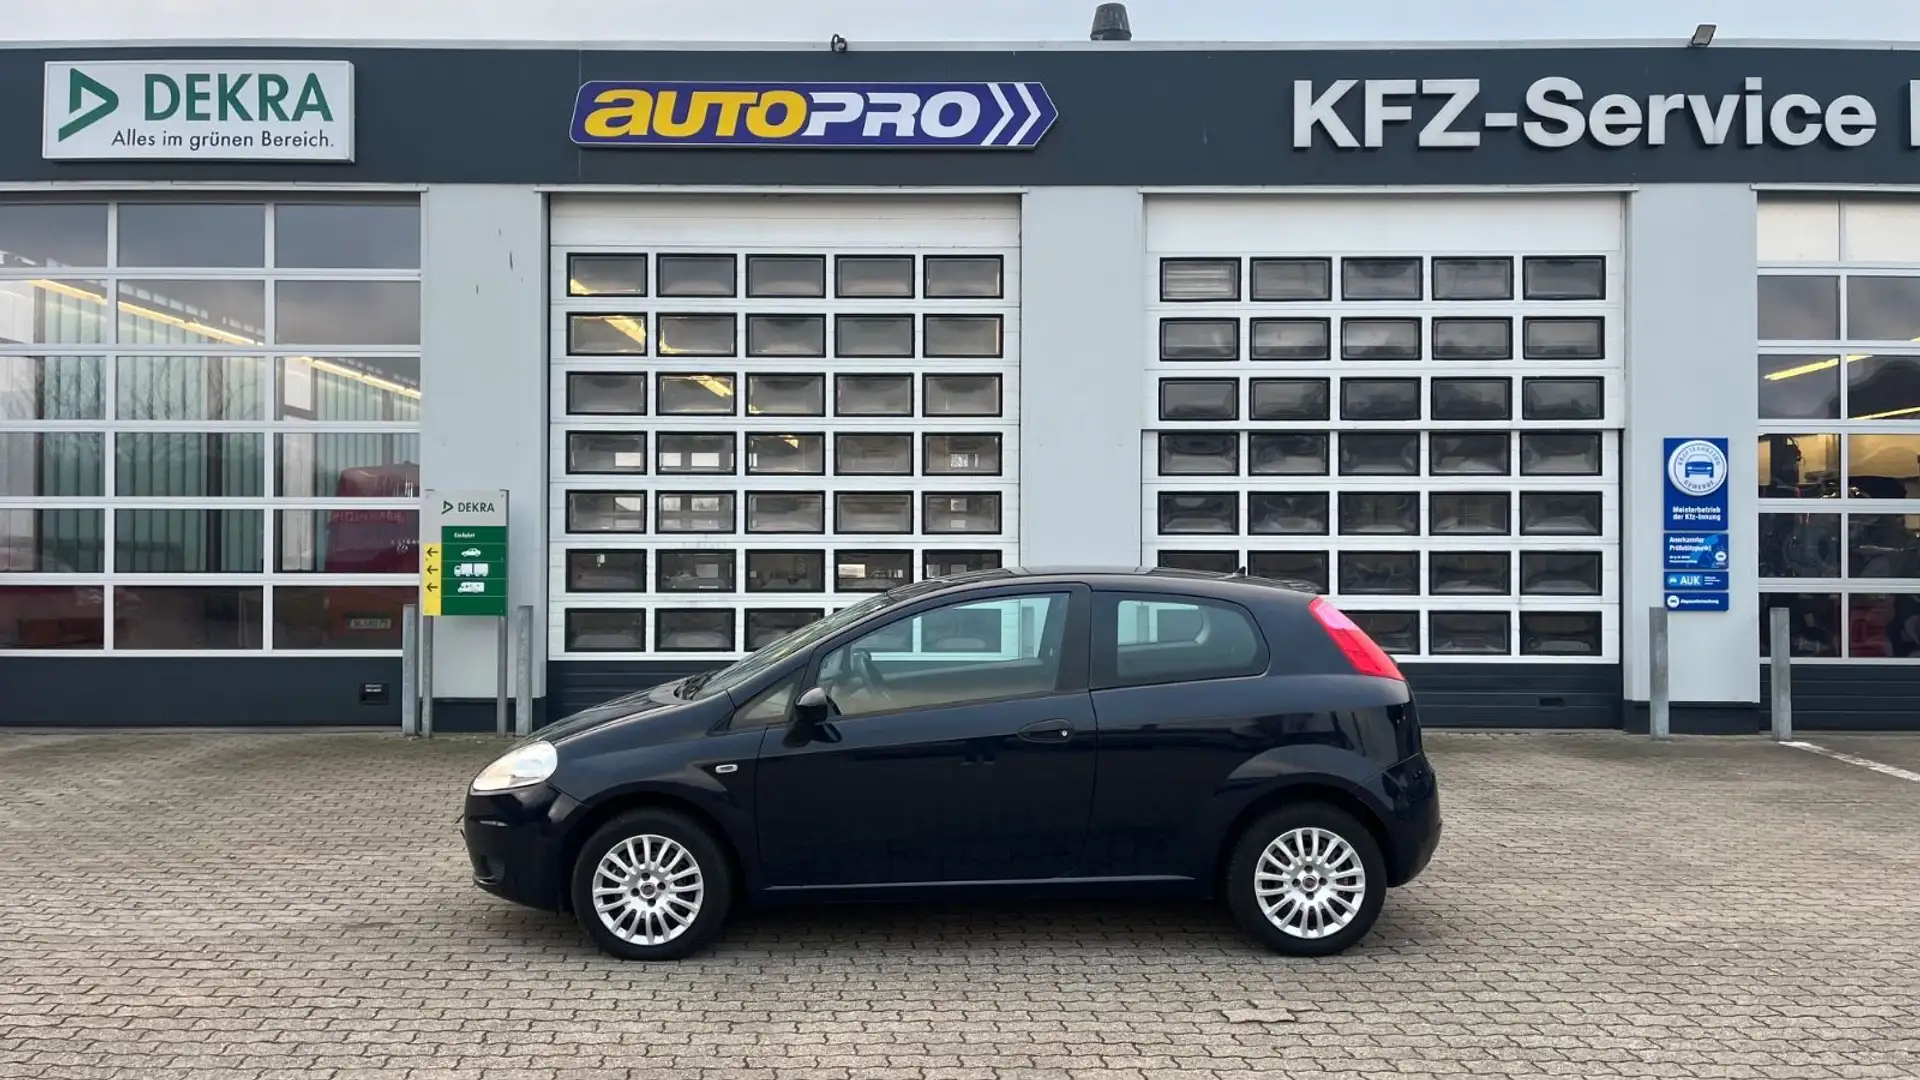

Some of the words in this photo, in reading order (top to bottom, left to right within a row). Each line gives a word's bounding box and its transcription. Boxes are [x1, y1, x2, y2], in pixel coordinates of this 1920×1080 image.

[144, 73, 334, 122] DEKRA
[1293, 76, 1878, 148] KFZ-Service
[111, 128, 155, 147] Alles
[162, 130, 182, 147] im
[189, 131, 253, 151] grünen
[261, 129, 334, 147] Bereich.
[458, 502, 495, 513] DEKRA
[1672, 506, 1721, 514] Meisterbetrieb
[1680, 575, 1701, 586] AUK
